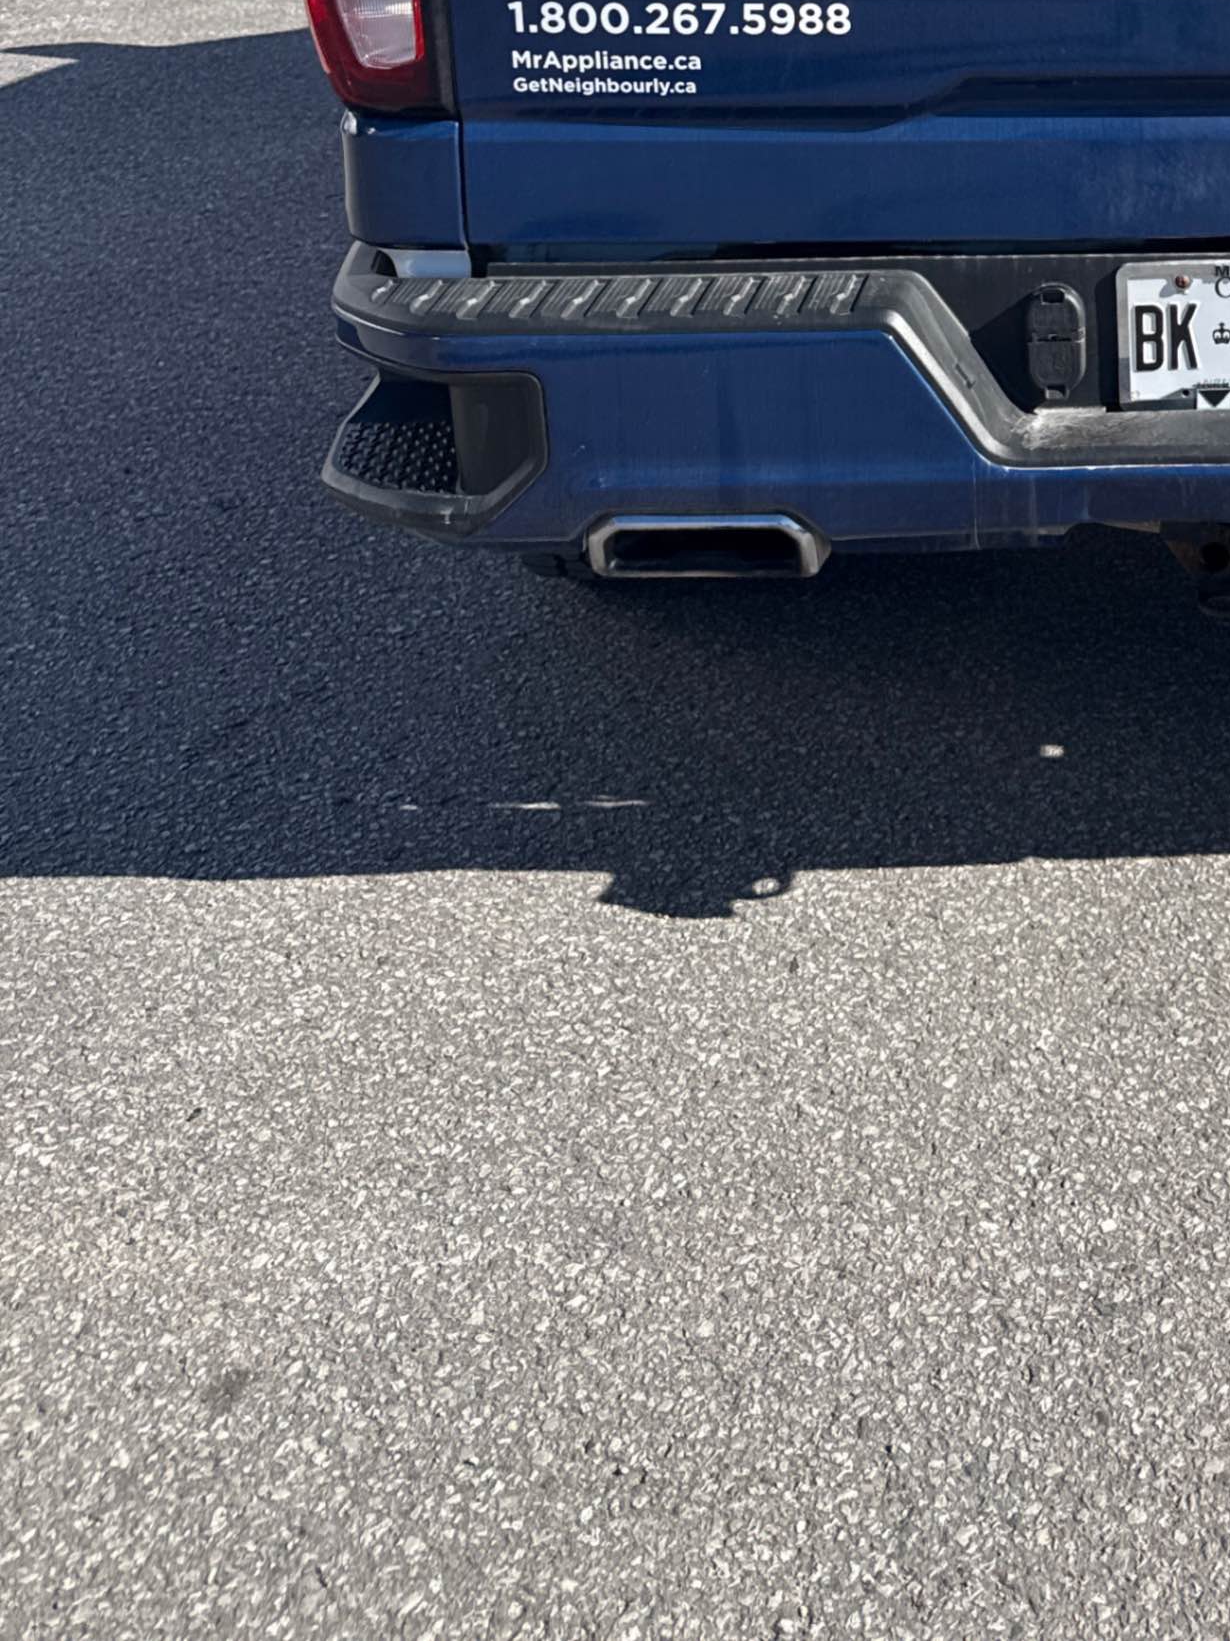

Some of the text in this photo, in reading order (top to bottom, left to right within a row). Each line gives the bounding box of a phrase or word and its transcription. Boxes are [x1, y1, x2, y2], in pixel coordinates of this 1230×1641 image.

[507, 1, 852, 35] 1.800.267.5988
[511, 50, 702, 73] MrAppliance.ca
[513, 76, 697, 96] GetNeighbourly.ca
[1133, 303, 1200, 372] BK
